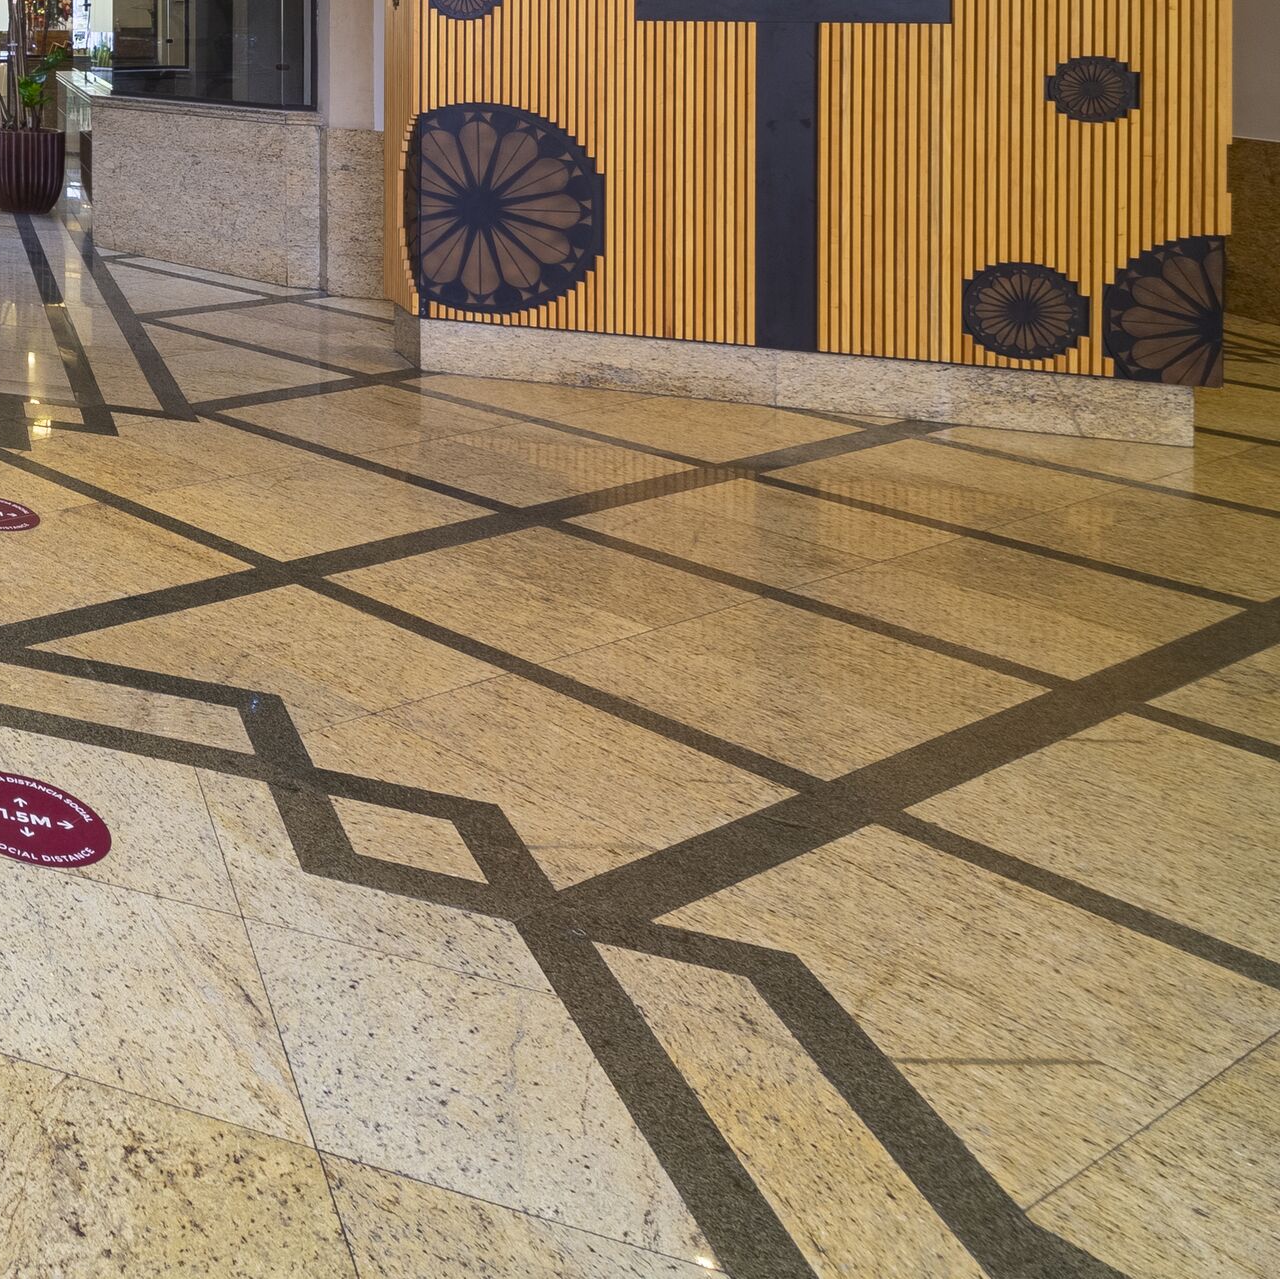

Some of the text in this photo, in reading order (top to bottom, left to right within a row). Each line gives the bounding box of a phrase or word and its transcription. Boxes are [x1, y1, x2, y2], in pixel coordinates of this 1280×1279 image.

[6, 776, 63, 801] DISTÂNCIA
[63, 798, 93, 823] SOCIAL
[41, 846, 95, 863] DISTANCE
